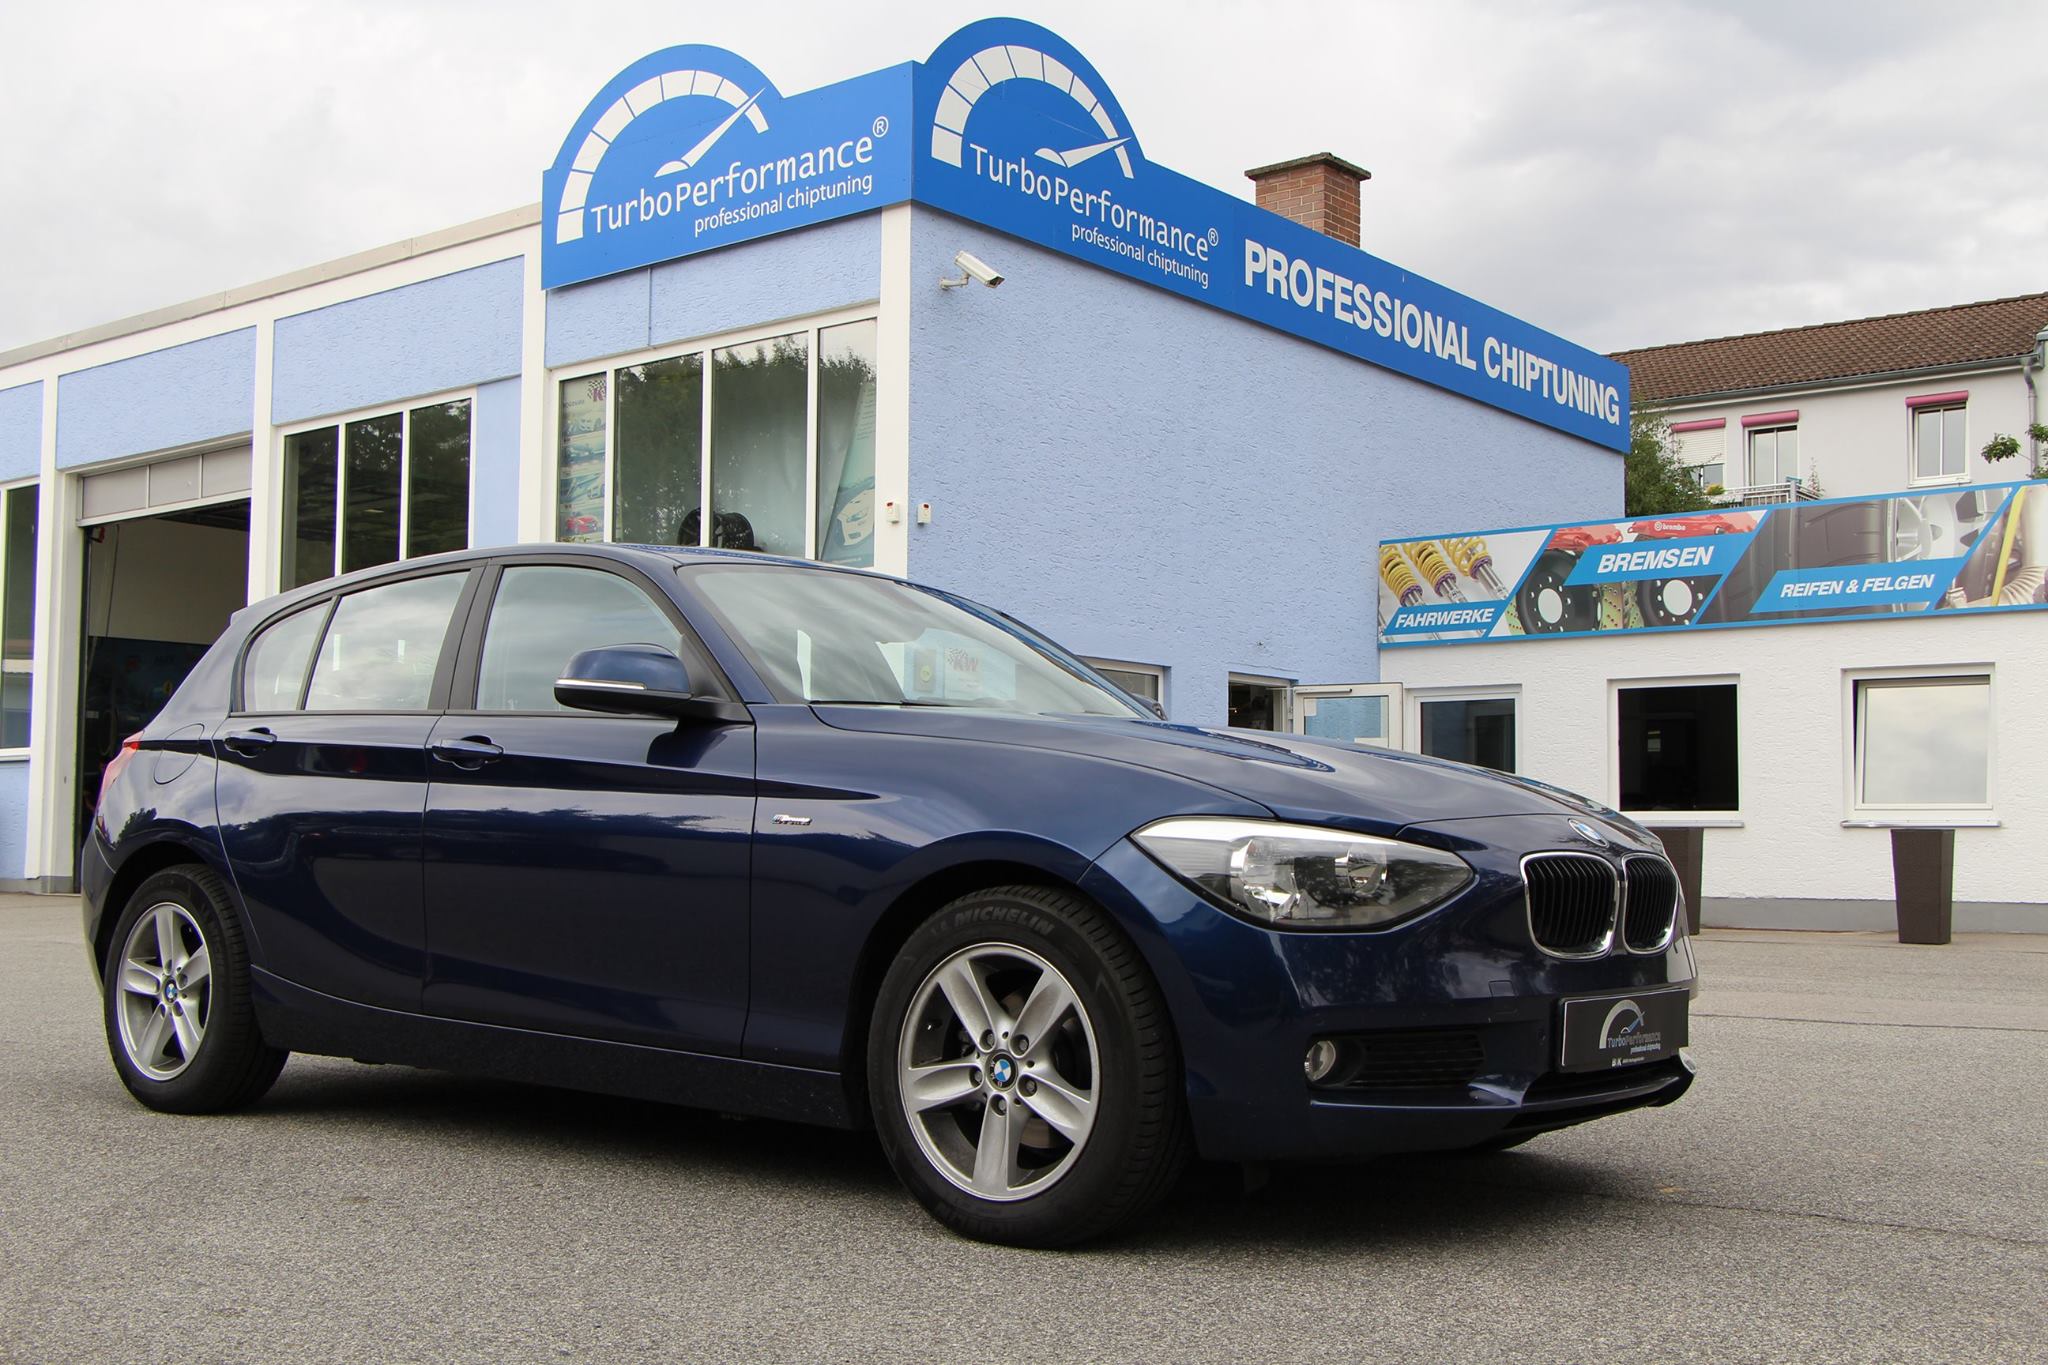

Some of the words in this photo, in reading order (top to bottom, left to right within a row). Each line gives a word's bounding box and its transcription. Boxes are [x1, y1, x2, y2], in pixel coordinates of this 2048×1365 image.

[695, 193, 782, 238] professional
[786, 174, 873, 209] chiptuning
[1072, 223, 1145, 263] professional
[1147, 249, 1209, 289] chiptuning
[1245, 239, 1477, 371] PROFESSIONAL
[1483, 336, 1620, 425] CHIPTUNING
[1597, 546, 1714, 574] BREMSEN
[1780, 579, 1845, 598] REIFEN
[1846, 579, 1859, 594] &
[1862, 574, 1934, 592] FELGEN
[1395, 608, 1495, 628] FAHRWERKE
[954, 906, 1055, 935] MICHELIN
